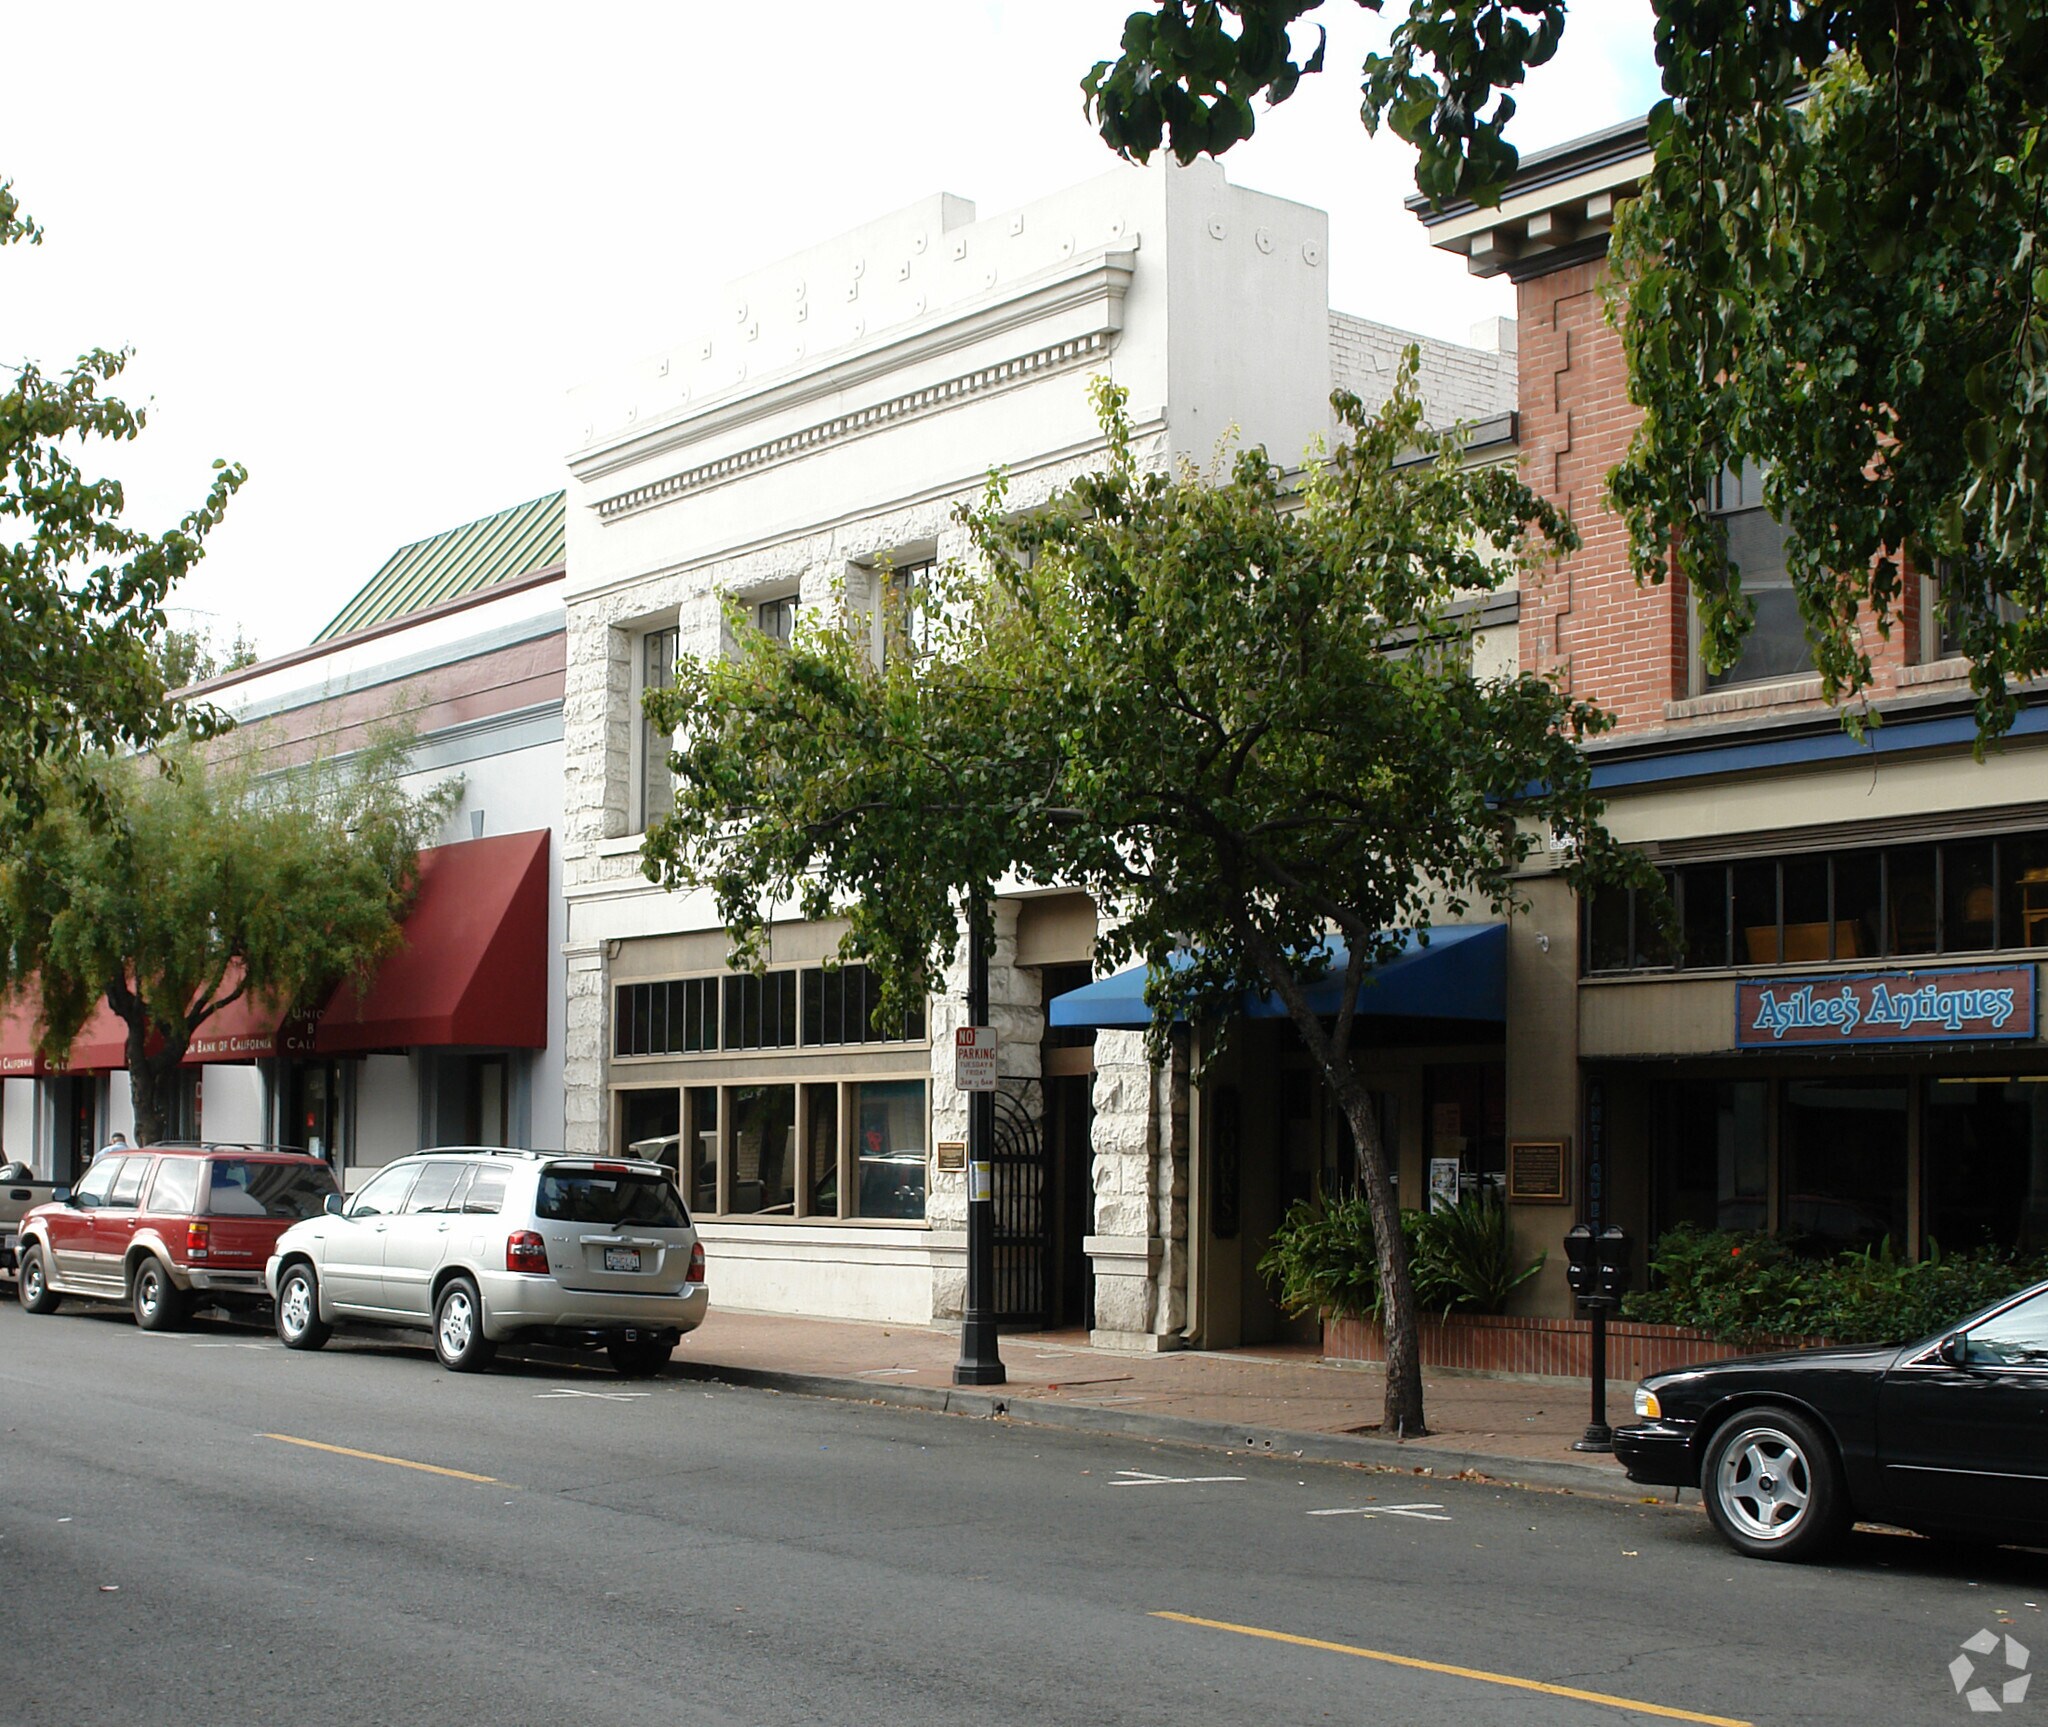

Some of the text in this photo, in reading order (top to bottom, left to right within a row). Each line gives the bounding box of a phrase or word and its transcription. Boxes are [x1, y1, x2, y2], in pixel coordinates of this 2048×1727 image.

[1753, 983, 2014, 1039] Asilee's Antiques
[197, 1039, 216, 1053] BANK
[230, 1036, 272, 1051] CALIFORNIA
[959, 1030, 973, 1044] NO
[959, 1048, 995, 1059] PARKING
